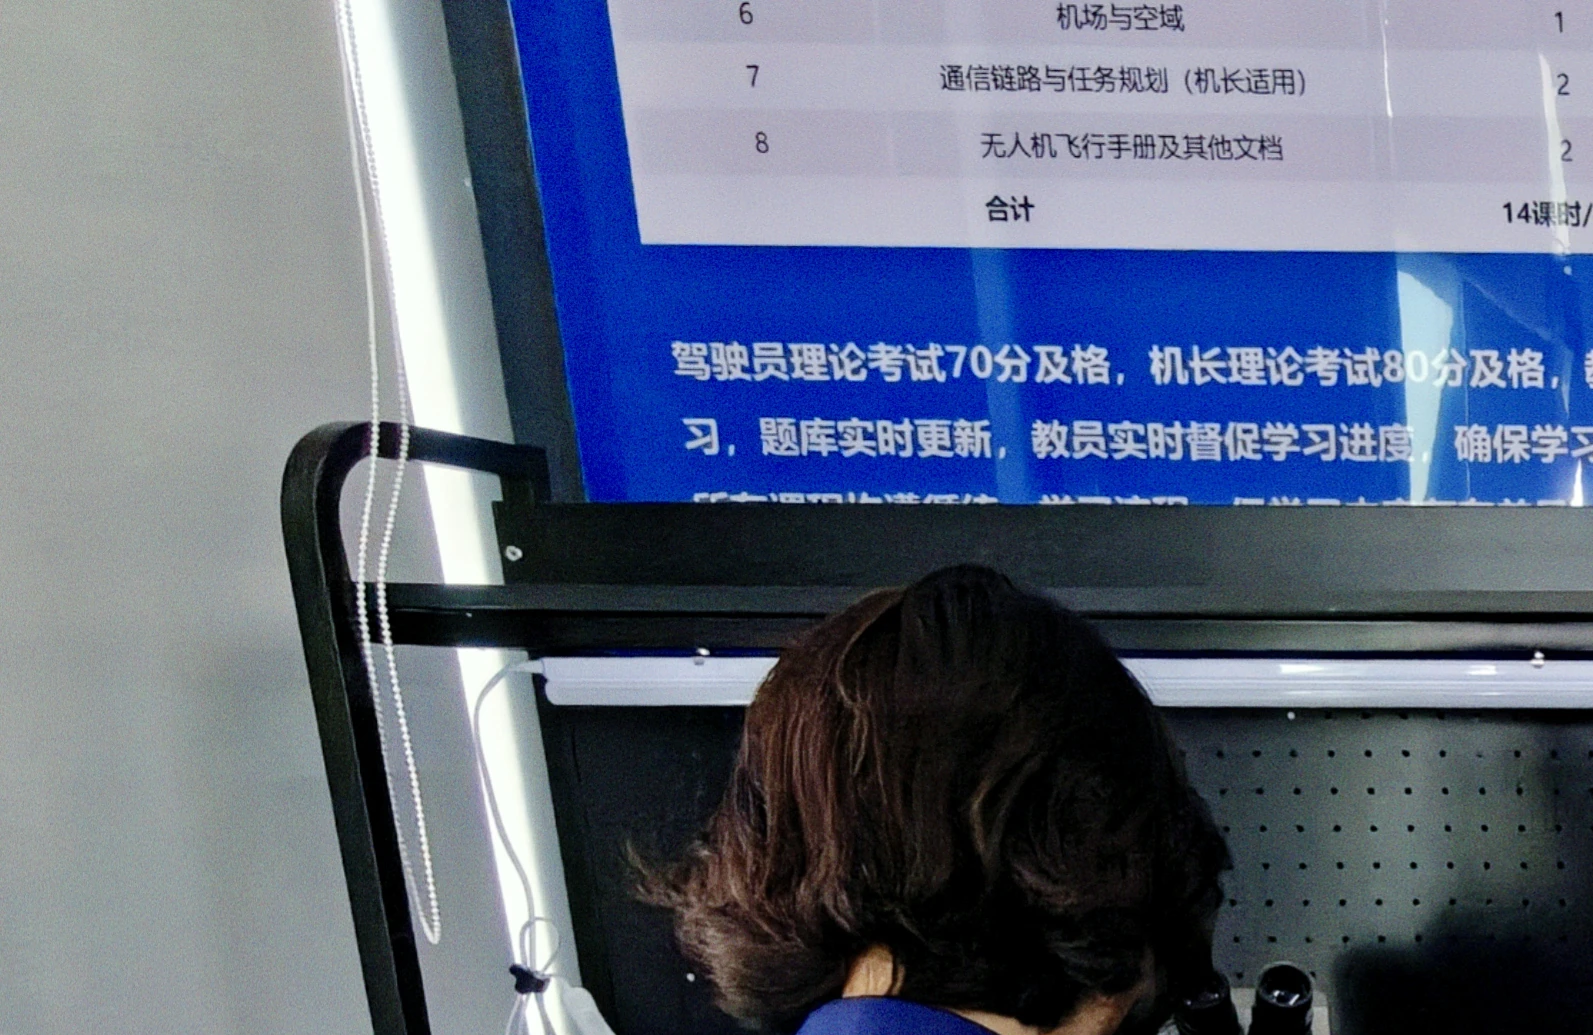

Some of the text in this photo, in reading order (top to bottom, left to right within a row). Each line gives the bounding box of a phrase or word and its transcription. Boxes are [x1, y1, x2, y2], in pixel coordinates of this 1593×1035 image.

[739, 2, 755, 26] 6
[1057, 3, 1187, 33] 机场与空域
[1554, 11, 1565, 34] 1
[746, 65, 761, 88] 7
[1556, 73, 1571, 97] 2
[755, 131, 771, 155] 8
[981, 132, 1286, 162] 无人机飞行手册及其他文档
[1560, 140, 1574, 163] 2
[985, 195, 1036, 224] 合计
